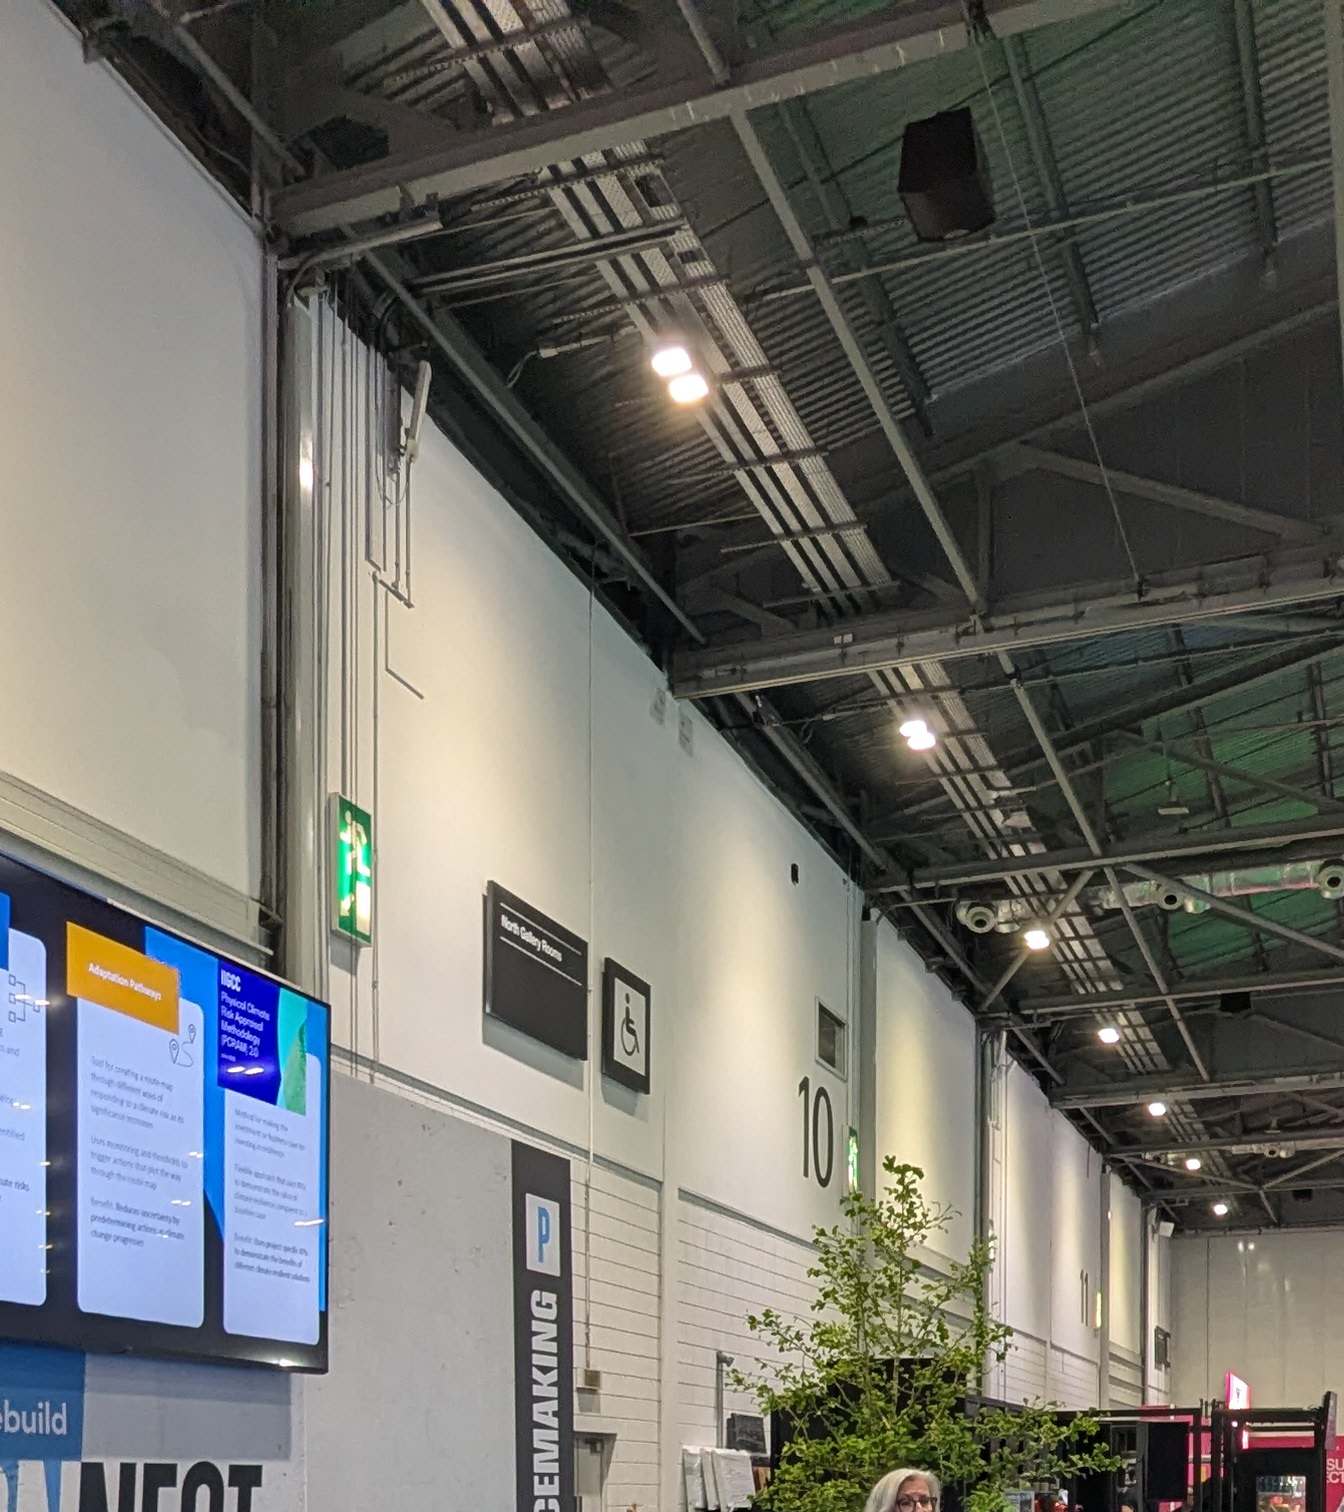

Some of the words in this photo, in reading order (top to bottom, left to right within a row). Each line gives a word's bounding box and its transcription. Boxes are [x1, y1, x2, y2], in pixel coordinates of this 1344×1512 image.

[501, 914, 519, 936] North
[520, 926, 541, 951] Gallery
[542, 939, 562, 962] Rooms
[88, 963, 129, 987] Adaptation
[130, 979, 162, 1001] Pathways
[221, 991, 246, 1011] Physical
[7, 1044, 19, 1056] and
[798, 1076, 834, 1188] 10
[14, 1178, 30, 1192] risks
[537, 1206, 550, 1263] P
